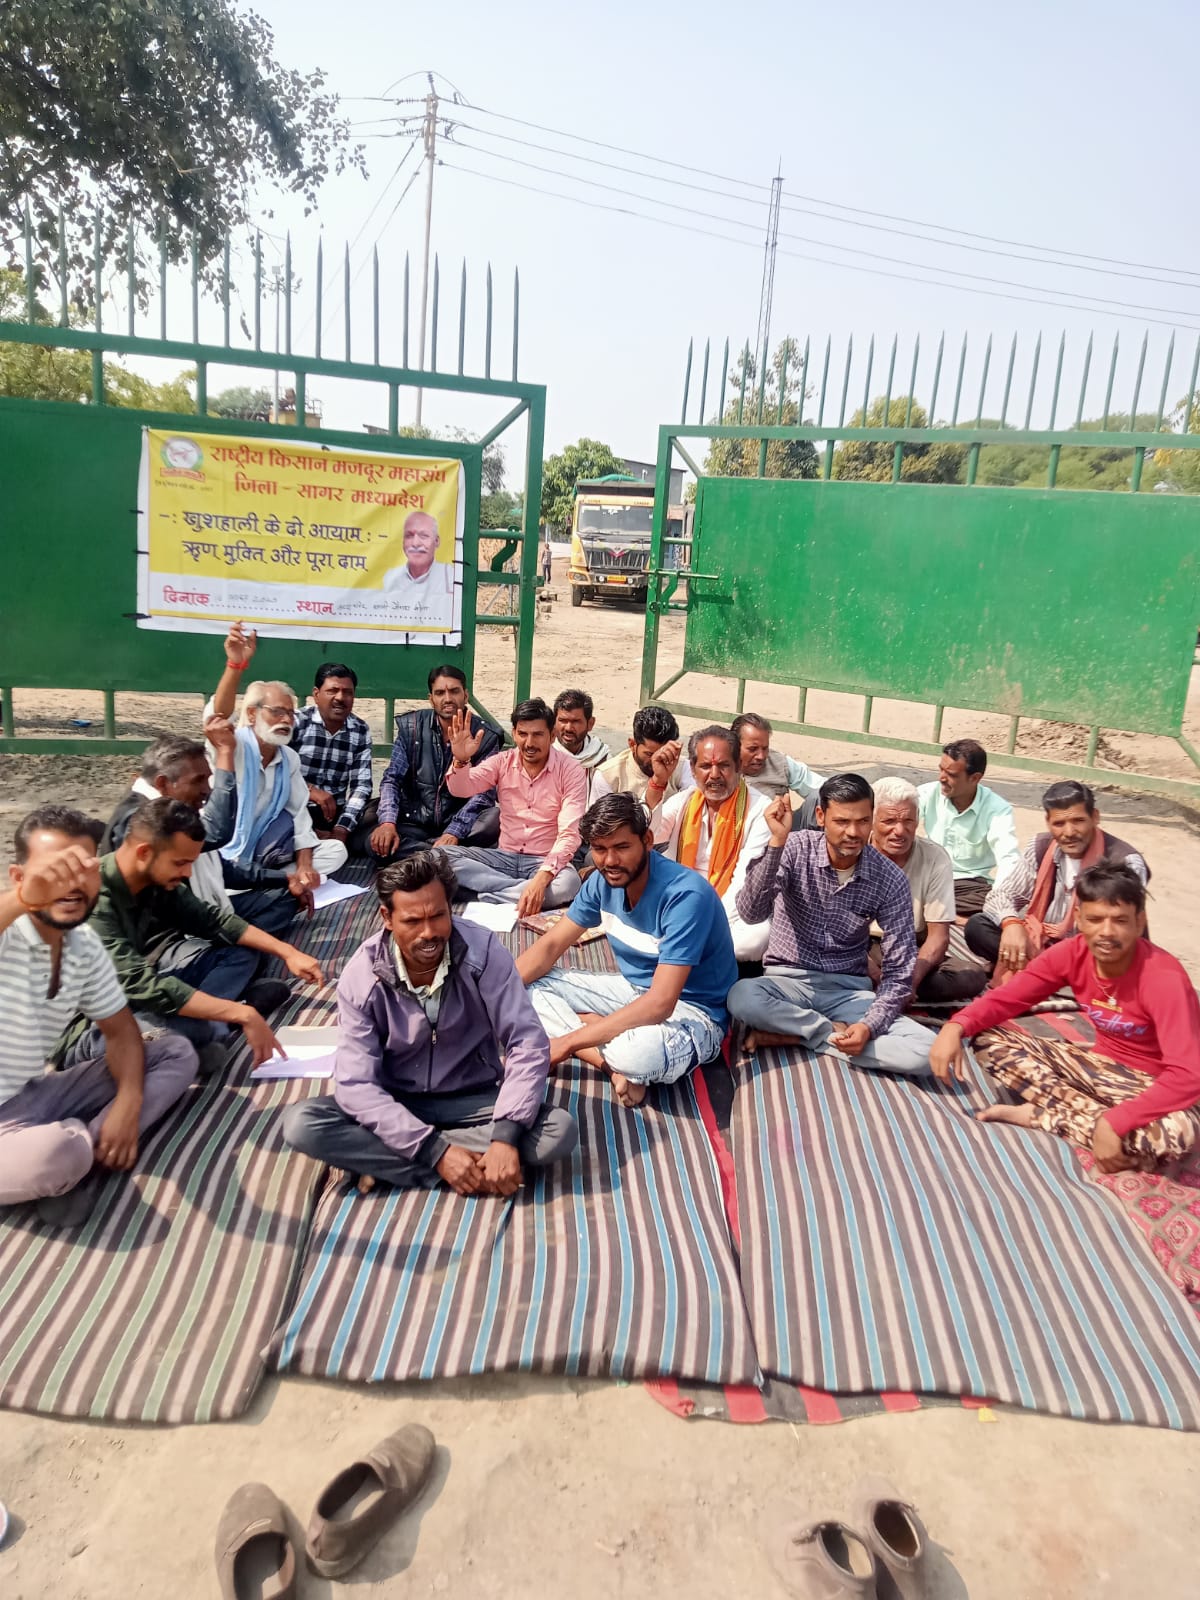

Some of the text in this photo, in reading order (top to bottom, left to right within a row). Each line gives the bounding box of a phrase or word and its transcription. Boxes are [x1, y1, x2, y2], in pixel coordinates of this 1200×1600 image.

[210, 444, 447, 485] राष्ट्रीय किसान मजदूर महासंघ
[235, 471, 277, 495] जिला
[296, 484, 345, 502] सागर
[351, 488, 424, 509] मध्यप्रदेश
[182, 510, 261, 535] खुशहाली
[264, 513, 282, 536] के
[285, 515, 306, 539] दो
[308, 523, 364, 543] आयाम
[181, 539, 369, 573] ऋण मुक्ति और पूरा दाम
[162, 585, 211, 606] दिनांक
[296, 600, 337, 615] स्थान
